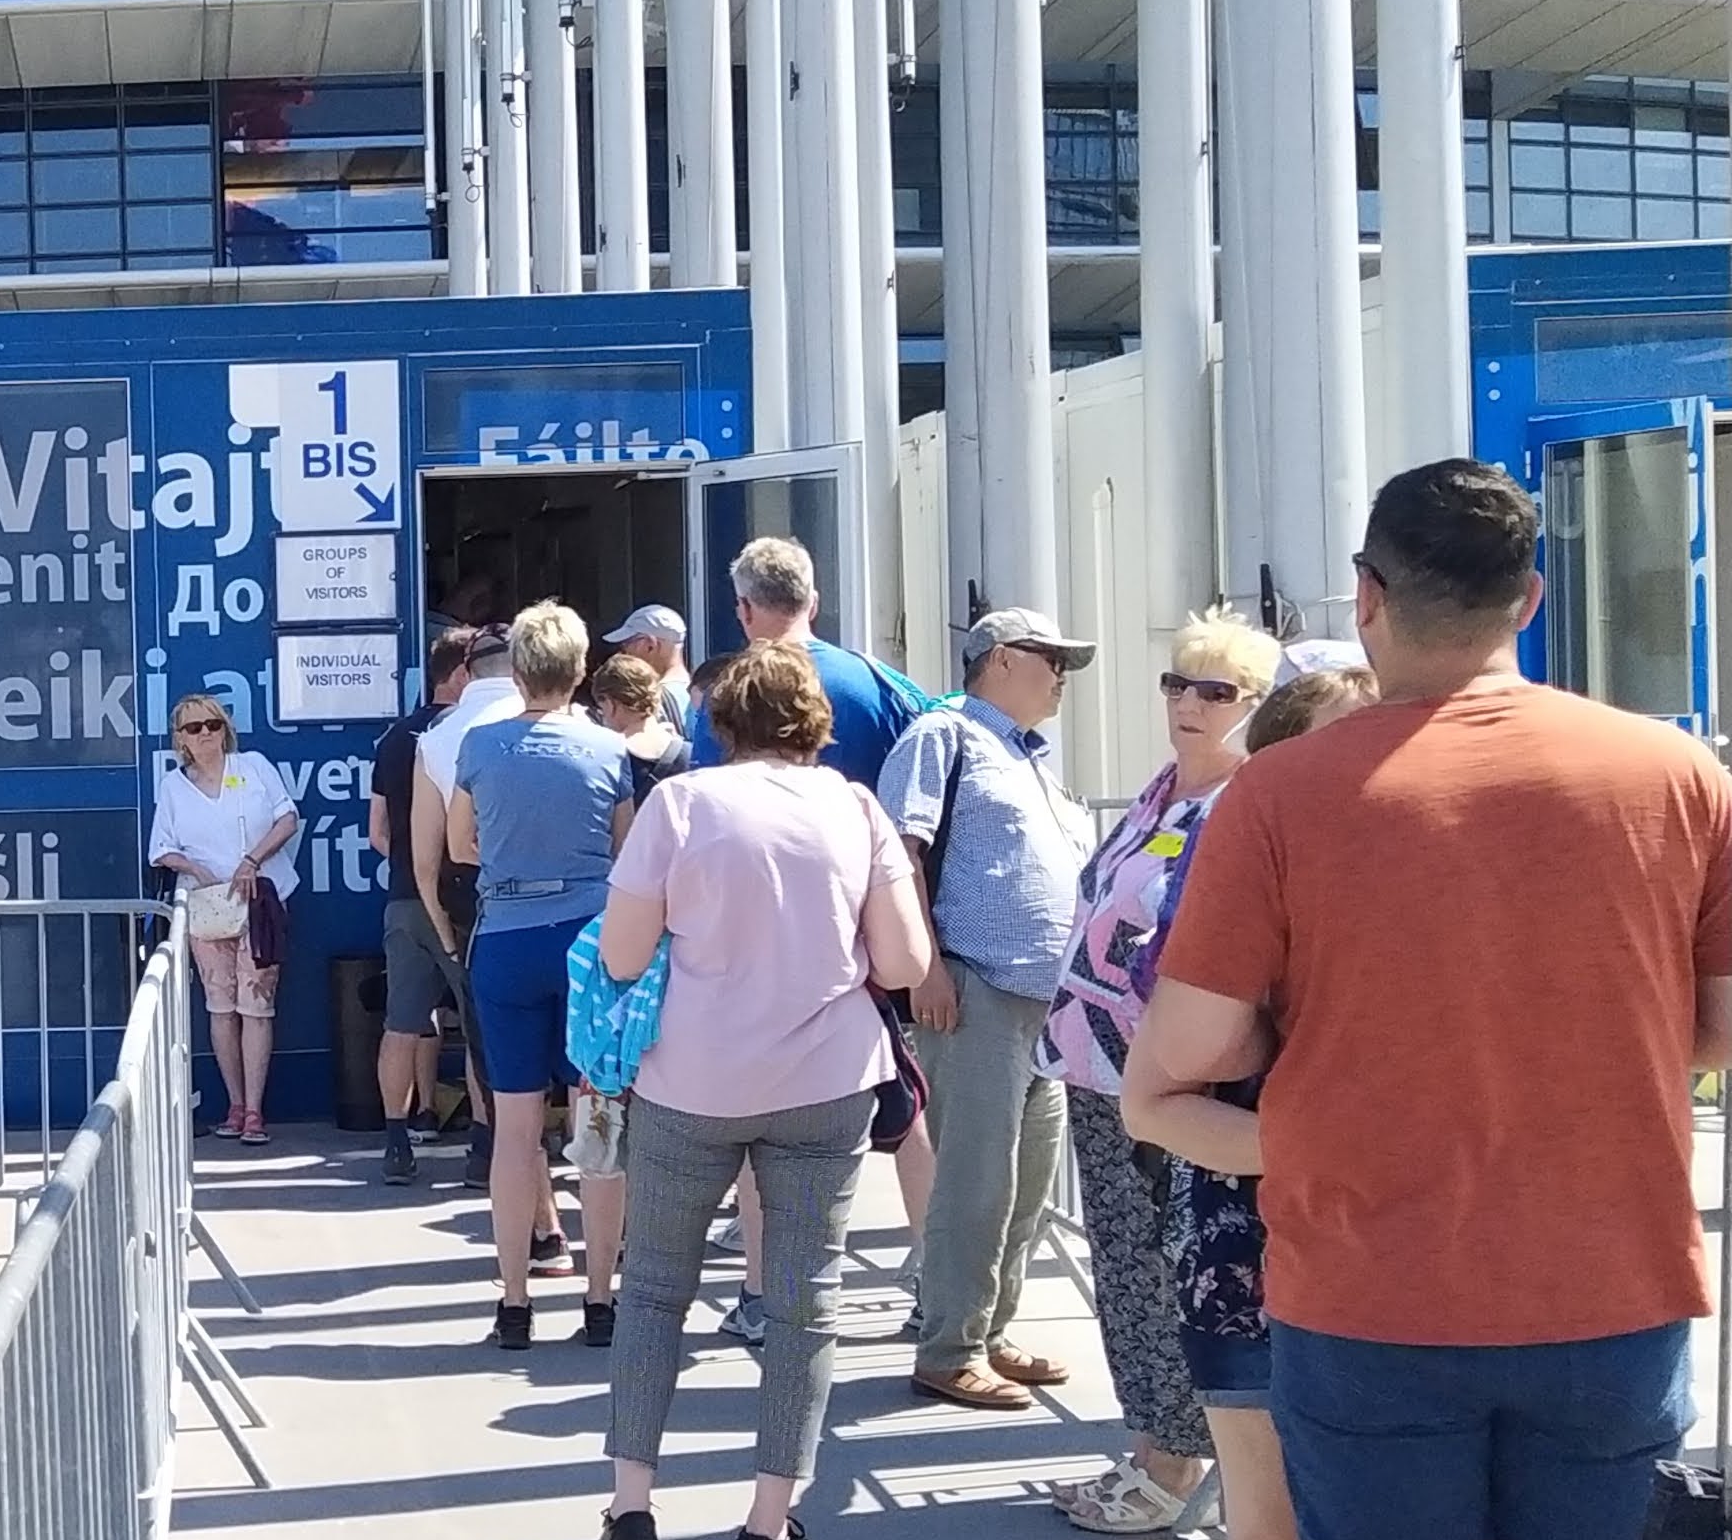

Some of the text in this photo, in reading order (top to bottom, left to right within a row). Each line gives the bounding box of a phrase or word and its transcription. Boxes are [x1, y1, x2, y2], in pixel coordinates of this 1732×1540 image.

[318, 370, 348, 436] 1
[302, 441, 378, 480] BIS
[302, 547, 368, 562] GROUPS
[325, 566, 346, 580] OF
[305, 585, 369, 601] VISITORS
[296, 654, 381, 668] INDIVIDUAL
[305, 672, 372, 687] VISITORS
